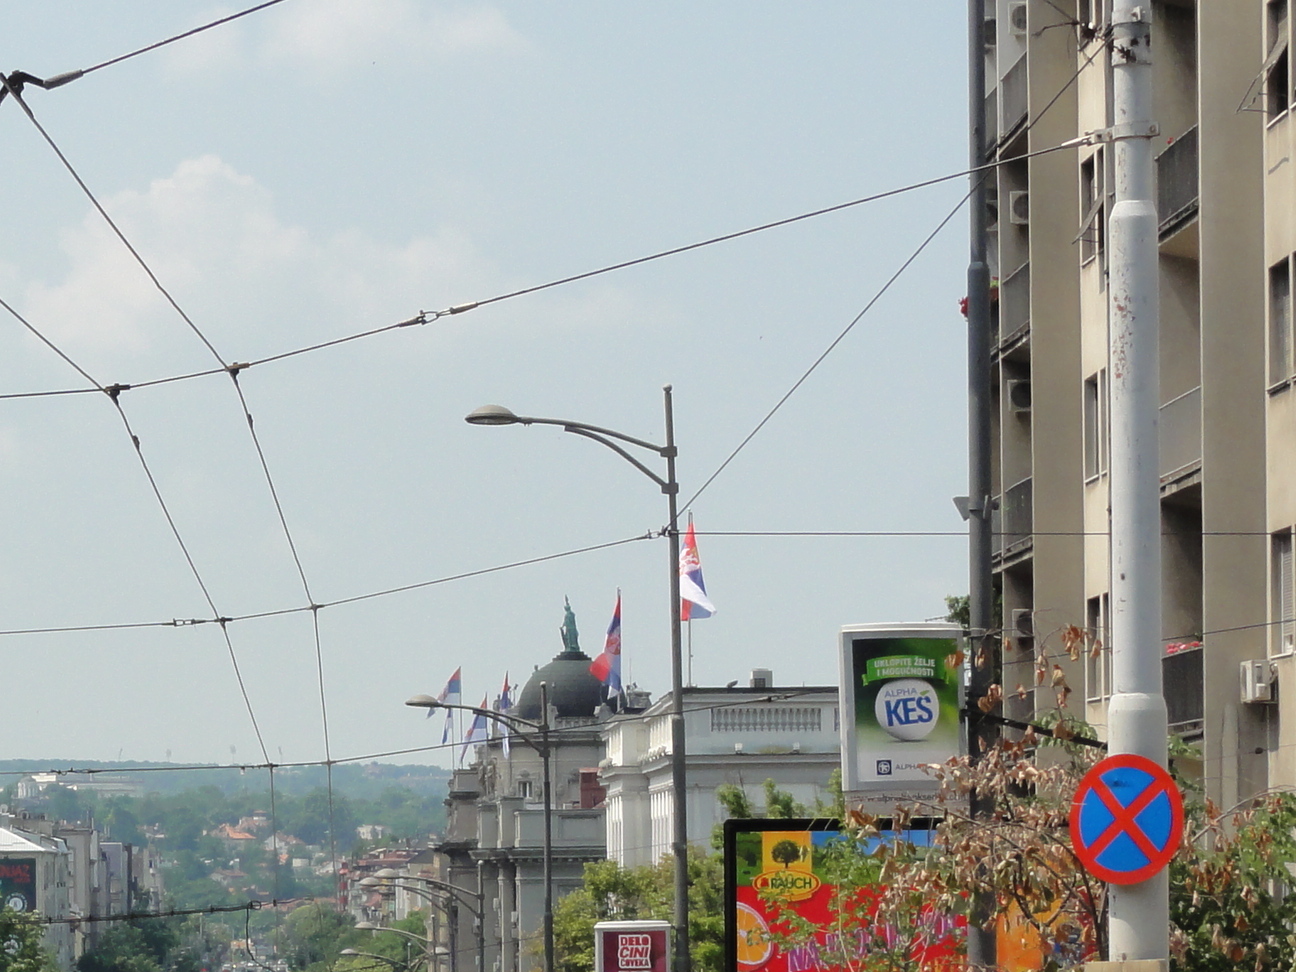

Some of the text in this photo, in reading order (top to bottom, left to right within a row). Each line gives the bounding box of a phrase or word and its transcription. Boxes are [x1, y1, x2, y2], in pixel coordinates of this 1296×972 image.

[885, 687, 917, 697] ALPHA
[770, 877, 812, 889] RAUCH
[621, 936, 649, 946] DELO
